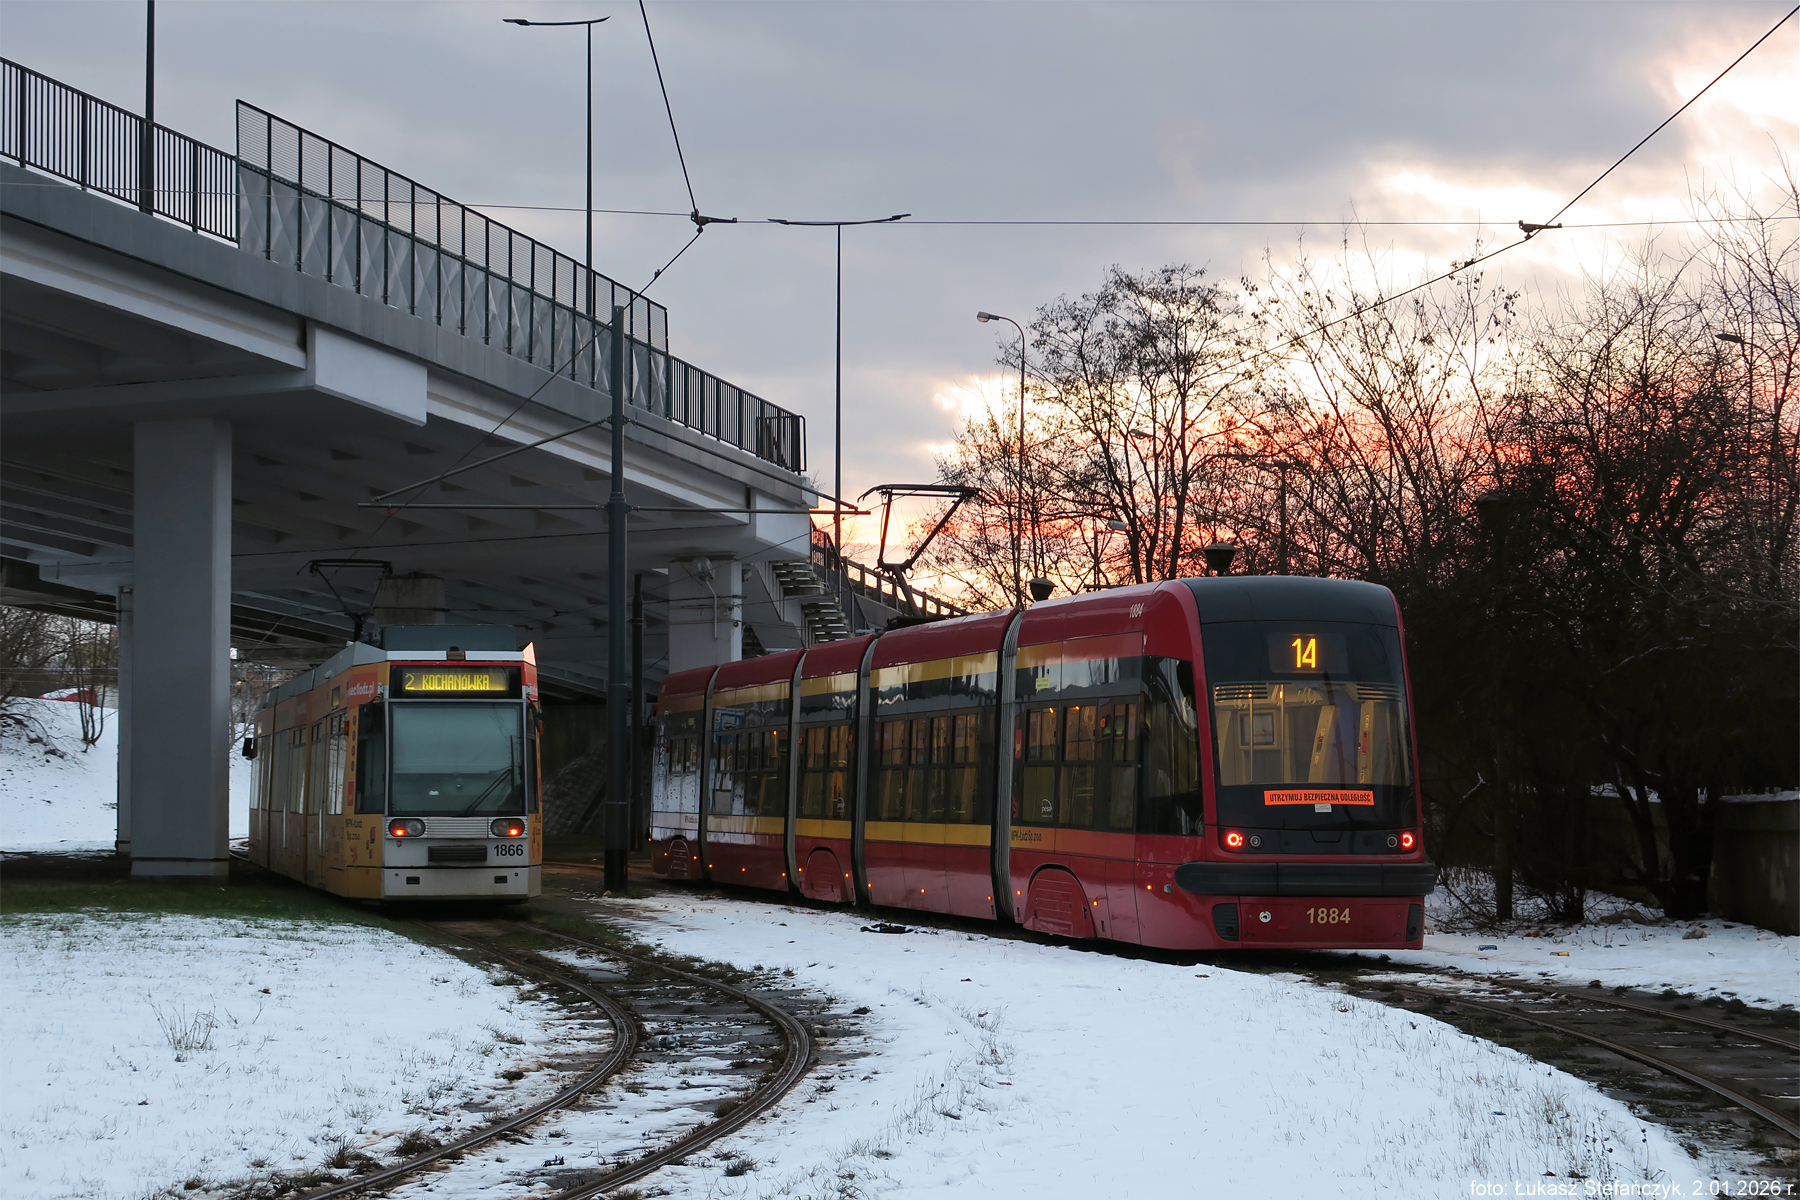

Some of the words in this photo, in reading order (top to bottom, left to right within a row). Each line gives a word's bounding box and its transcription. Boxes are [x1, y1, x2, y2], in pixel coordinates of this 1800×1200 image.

[1129, 602, 1144, 618] 1884
[1291, 637, 1316, 668] 14
[405, 673, 415, 690] 2
[422, 674, 489, 690] KOCHANÓWKA
[1269, 793, 1302, 802] UTRZYMUJ
[1304, 793, 1339, 802] BEZPIECZNĄ
[1340, 793, 1371, 802] ODLEGŁOŚĆ
[493, 844, 523, 857] 1866
[1306, 907, 1351, 924] 1884
